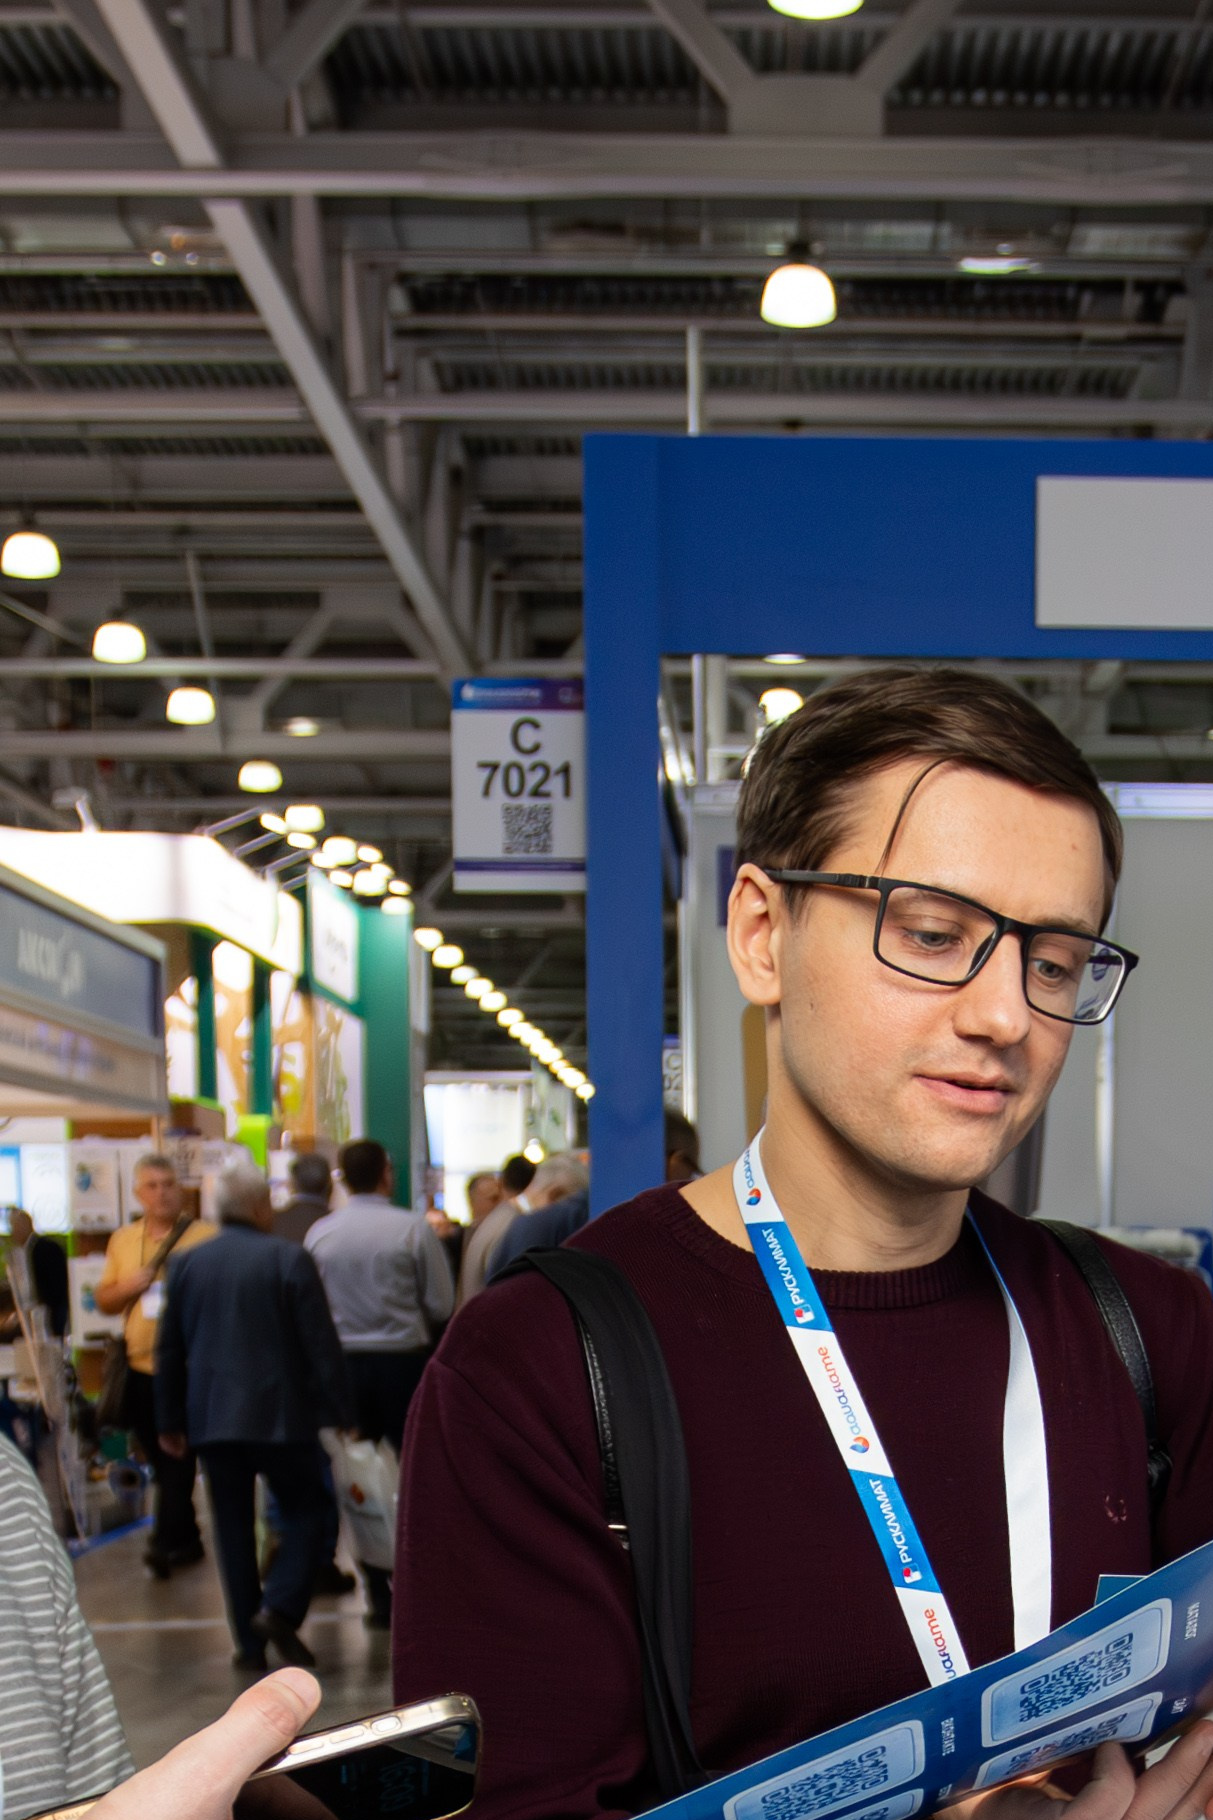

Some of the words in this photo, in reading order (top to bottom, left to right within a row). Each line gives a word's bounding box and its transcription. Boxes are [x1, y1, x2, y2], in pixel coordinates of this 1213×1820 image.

[476, 760, 572, 799] 7021
[761, 1227, 804, 1305] РУСКЛИМАТ
[816, 1344, 861, 1437] aquaflame
[868, 1477, 912, 1565] РУСКЛИМАТ
